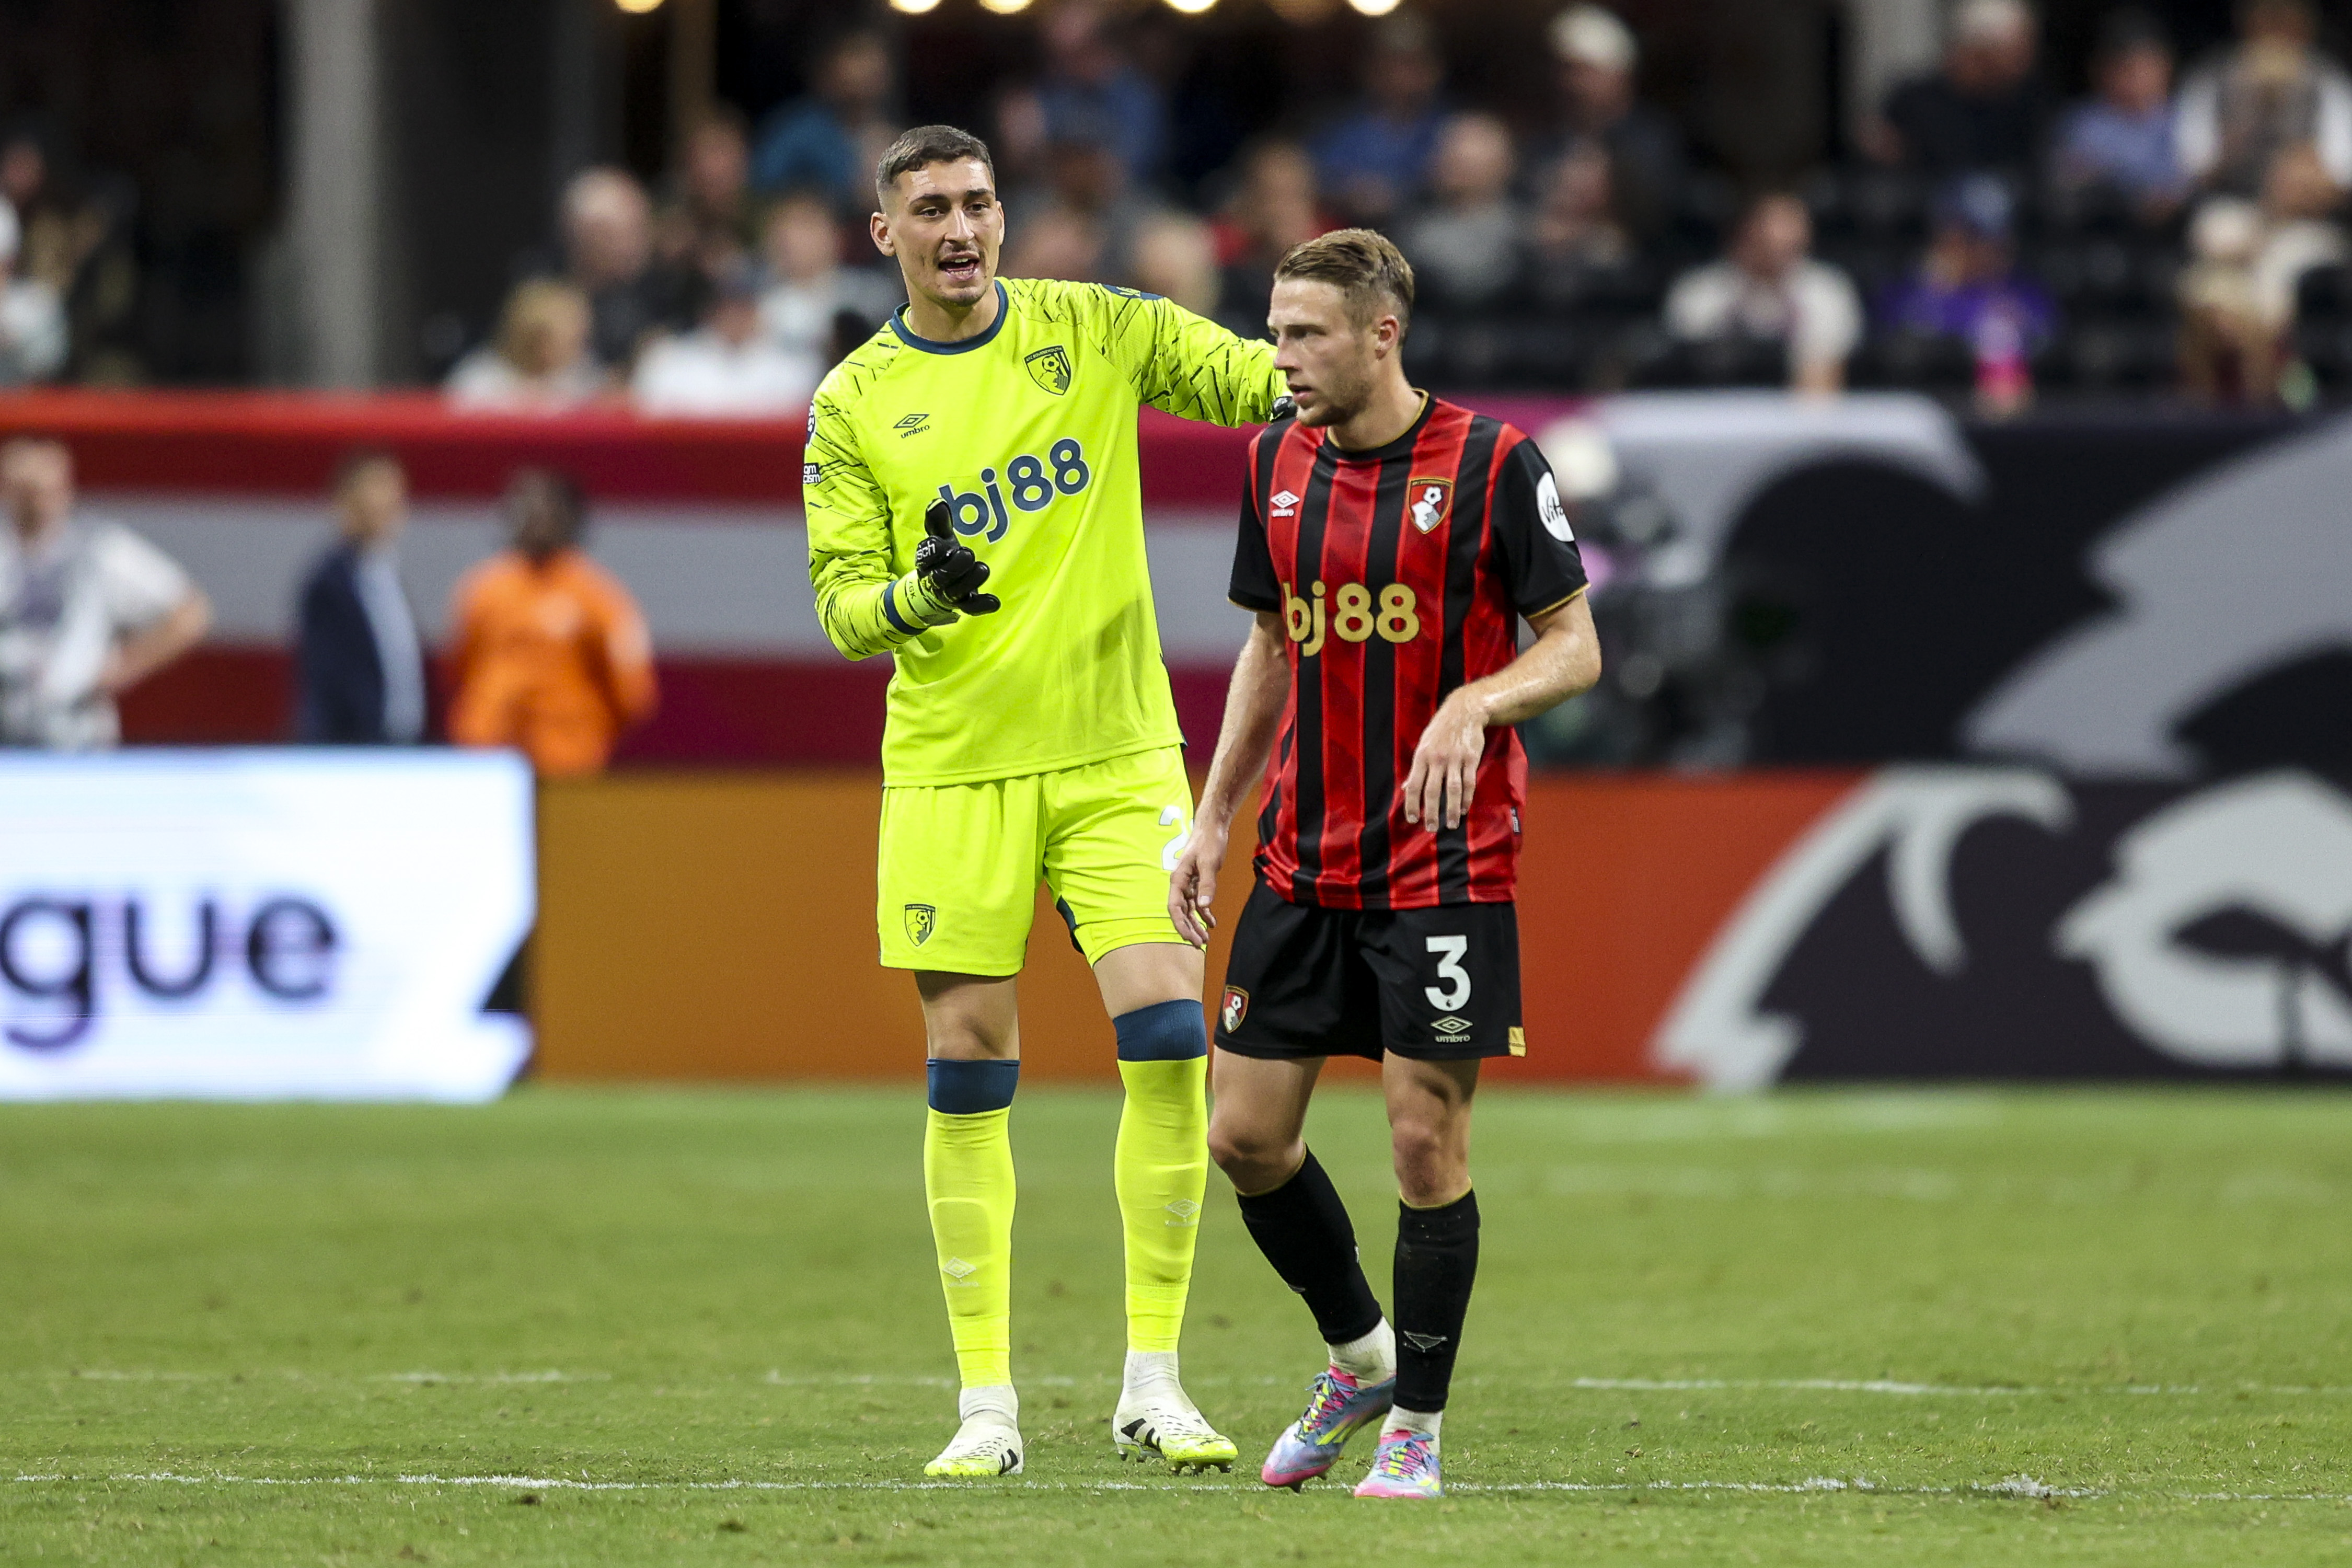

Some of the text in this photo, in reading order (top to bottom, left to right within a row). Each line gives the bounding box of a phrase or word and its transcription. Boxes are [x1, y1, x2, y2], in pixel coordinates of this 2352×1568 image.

[901, 425, 930, 439] umbro
[938, 438, 1090, 545] bj88
[1282, 580, 1420, 657] bj88
[1158, 805, 1194, 871] 2
[1424, 935, 1472, 1011] 3
[1434, 1034, 1471, 1043] umbro
